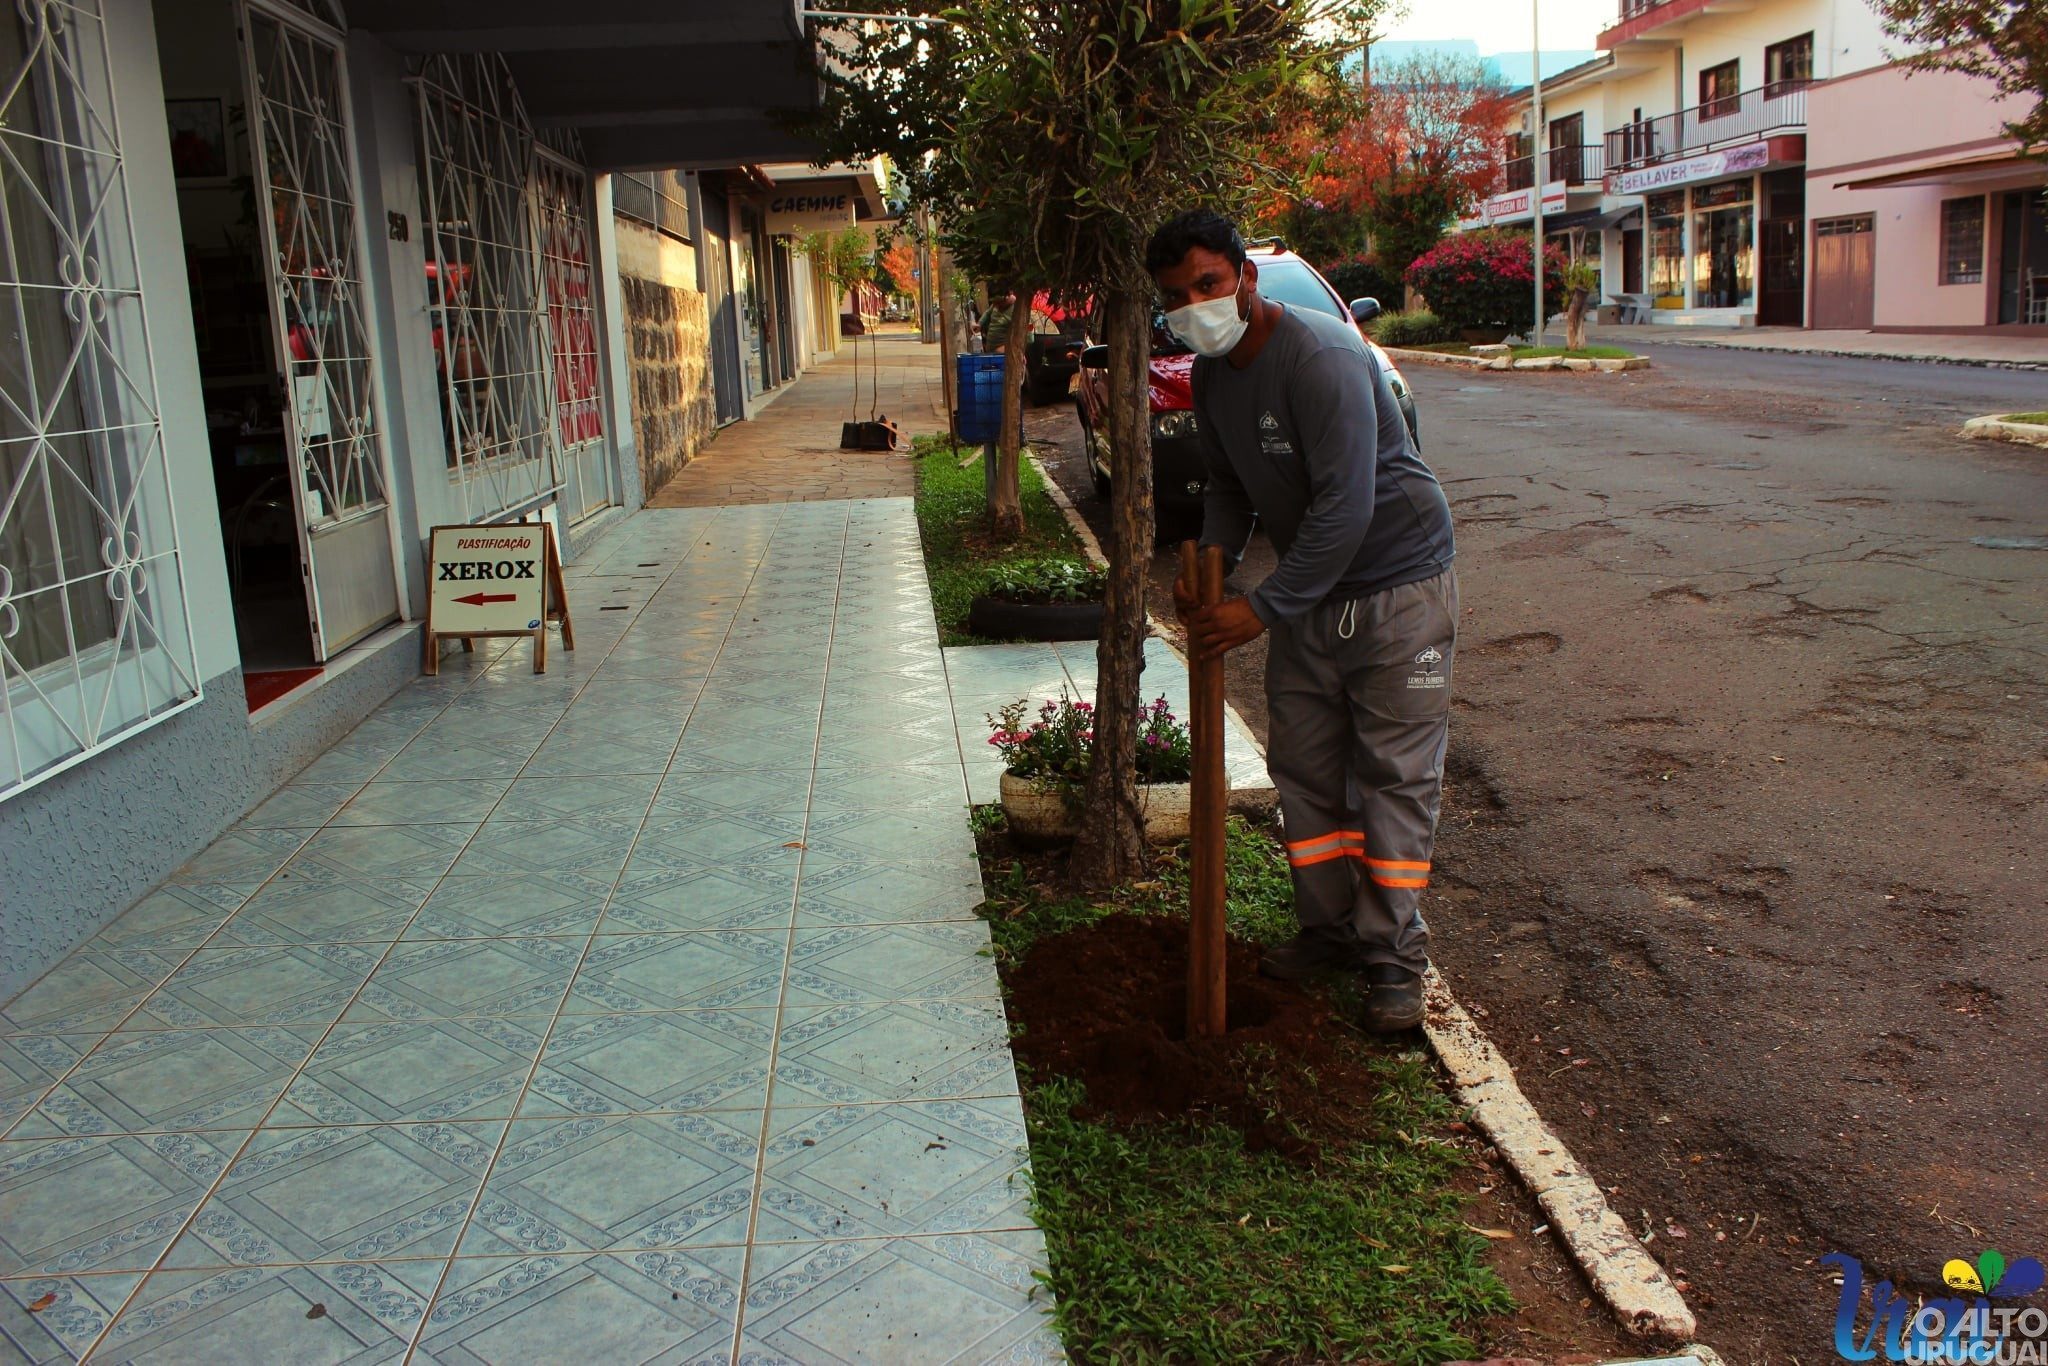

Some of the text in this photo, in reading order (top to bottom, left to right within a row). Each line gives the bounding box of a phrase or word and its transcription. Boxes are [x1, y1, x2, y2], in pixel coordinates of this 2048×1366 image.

[1624, 164, 1687, 190] BELLAVER
[457, 536, 531, 551] PLASTIFICAÇÃO
[439, 560, 535, 581] XEROX
